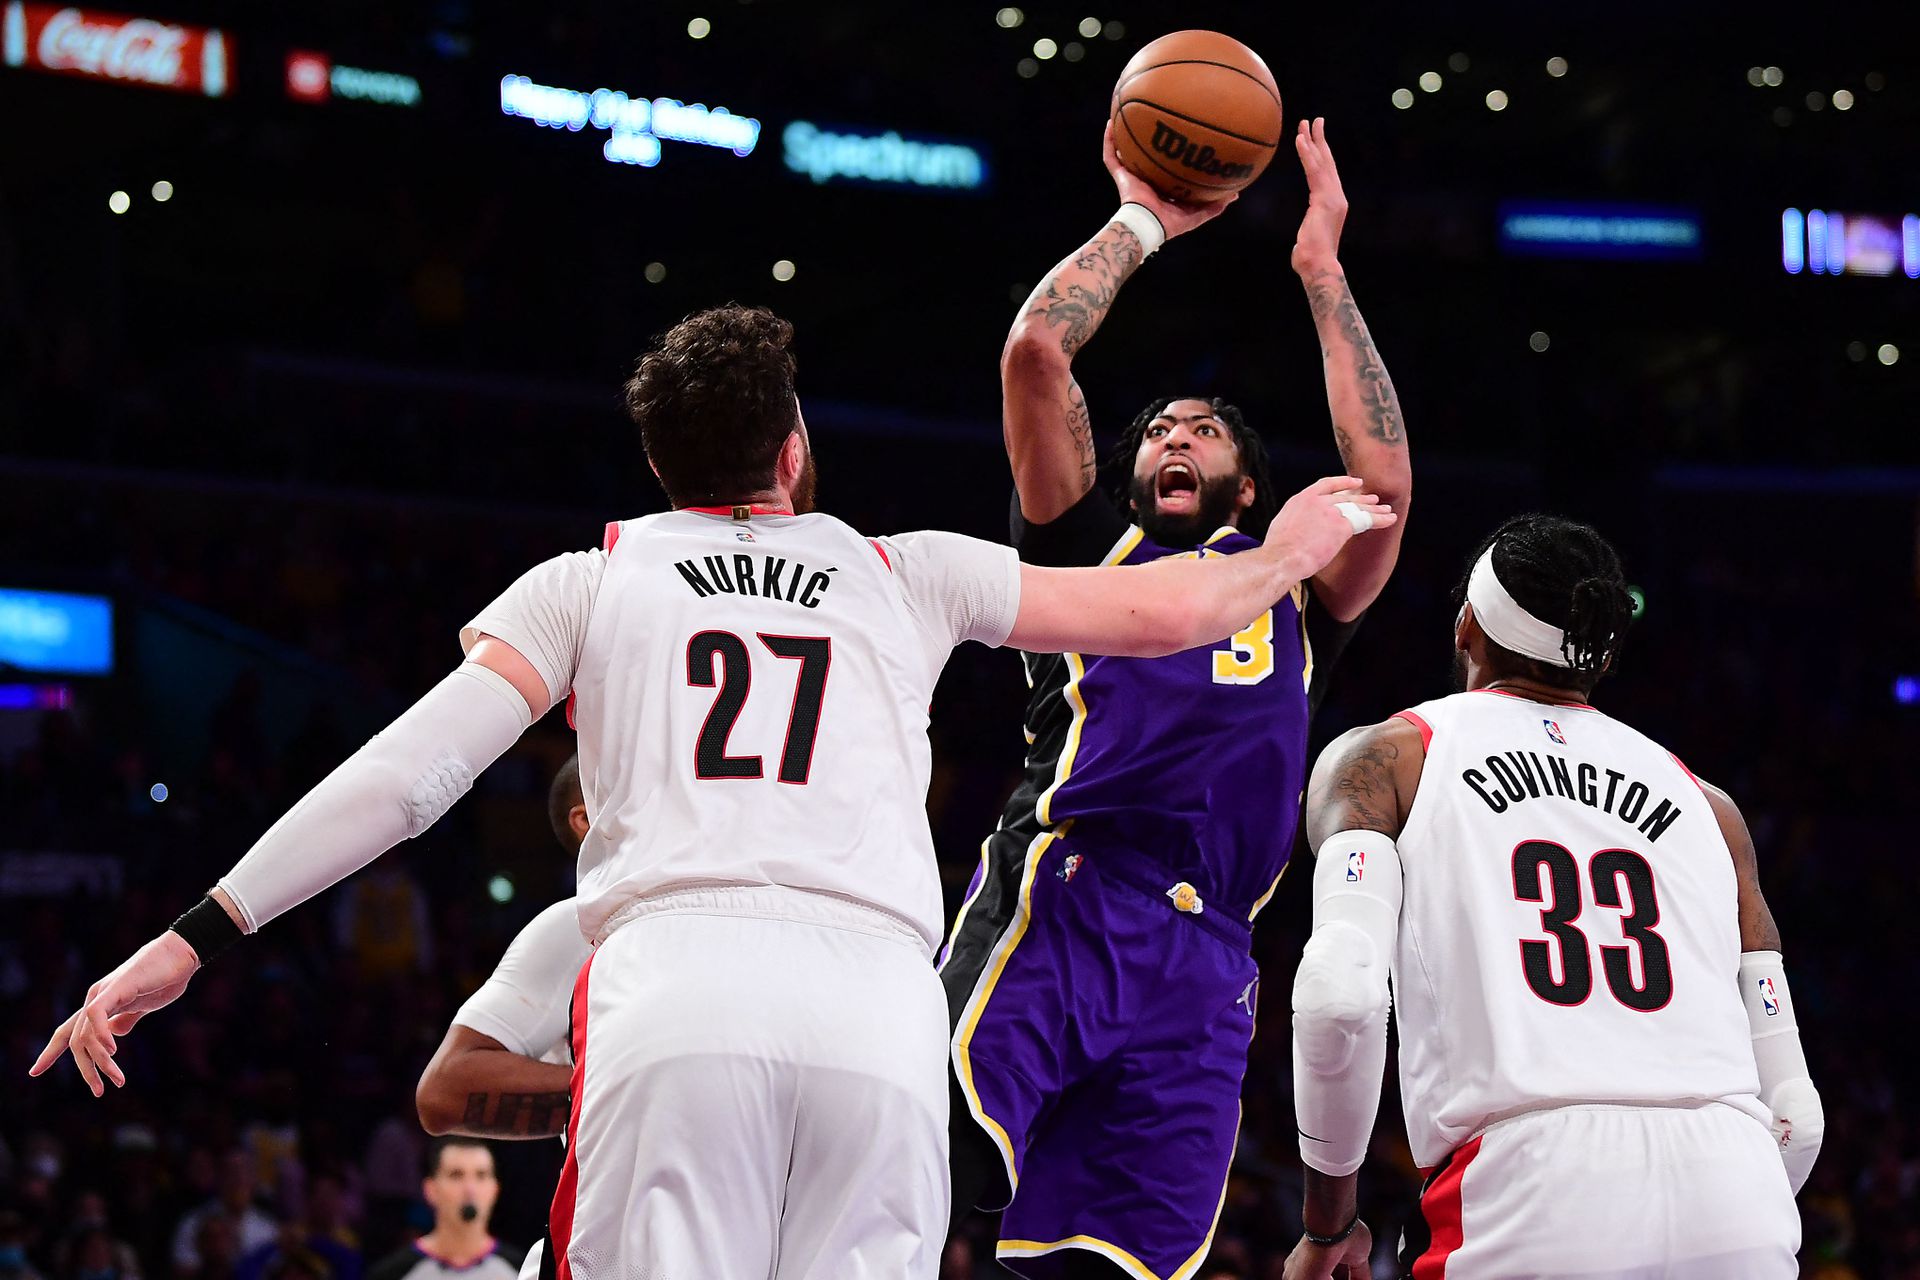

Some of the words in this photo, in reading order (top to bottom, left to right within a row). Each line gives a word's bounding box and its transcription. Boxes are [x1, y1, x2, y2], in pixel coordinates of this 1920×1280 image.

[783, 120, 982, 188] Spectrum
[1152, 120, 1254, 179] Wilson
[674, 553, 838, 609] NURKIĆ
[1212, 608, 1274, 685] 3
[686, 629, 832, 785] 27
[1462, 751, 1682, 843] COVINGTON
[1511, 839, 1674, 1013] 33
